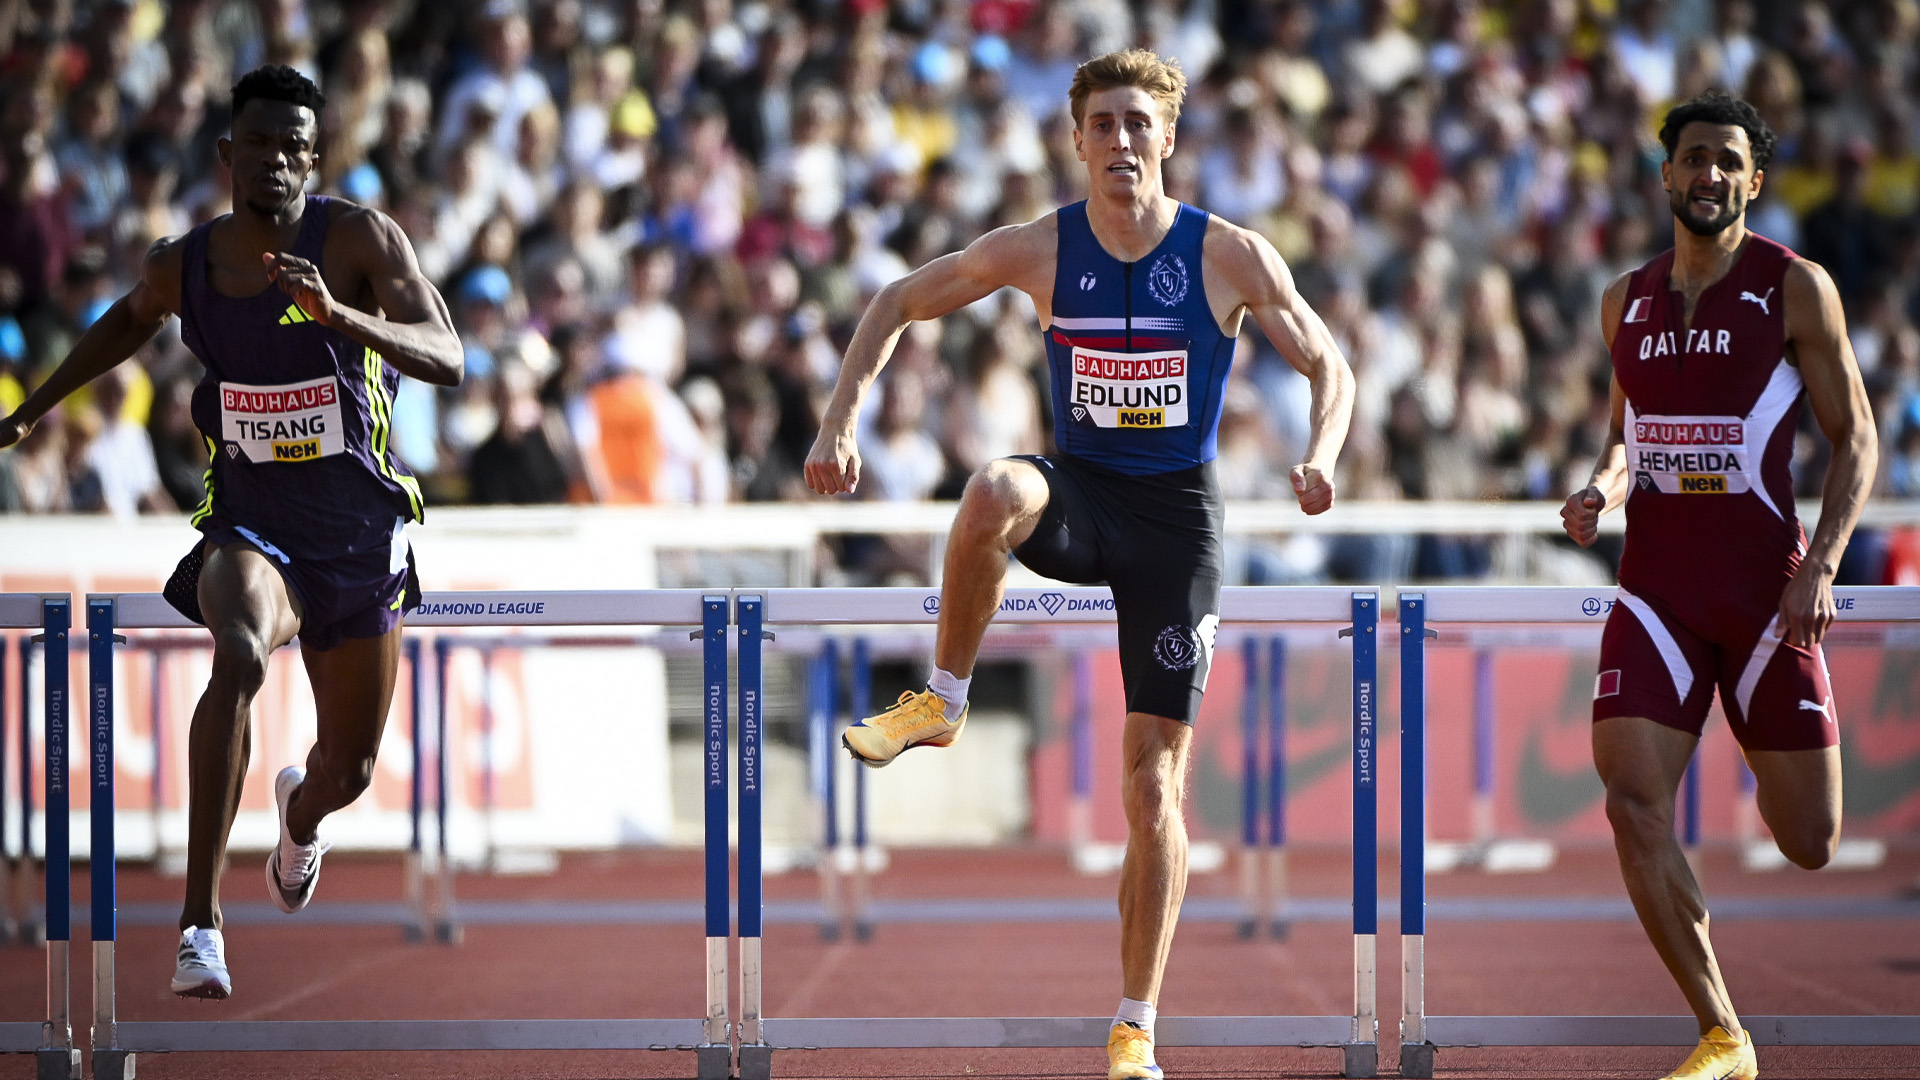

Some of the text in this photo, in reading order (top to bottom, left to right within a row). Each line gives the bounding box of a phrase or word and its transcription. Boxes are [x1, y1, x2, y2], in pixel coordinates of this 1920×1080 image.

[1639, 329, 1731, 360] QATAR
[1076, 357, 1182, 378] BAUHAUS
[225, 385, 334, 411] BAUHAUS
[1076, 381, 1182, 408] EDLUND
[235, 414, 326, 440] TISANG
[1636, 424, 1741, 442] BAUHAUS
[1639, 451, 1742, 472] HEMEIDA
[417, 602, 545, 615] DIAMOND LEAGUE
[1067, 599, 1116, 611] DIAMO
[52, 690, 63, 742] nordic
[96, 687, 109, 788] nordic Sport
[709, 685, 722, 786] nordic Sport
[744, 690, 757, 791] nordic Sport
[1358, 682, 1372, 783] nordic Sport
